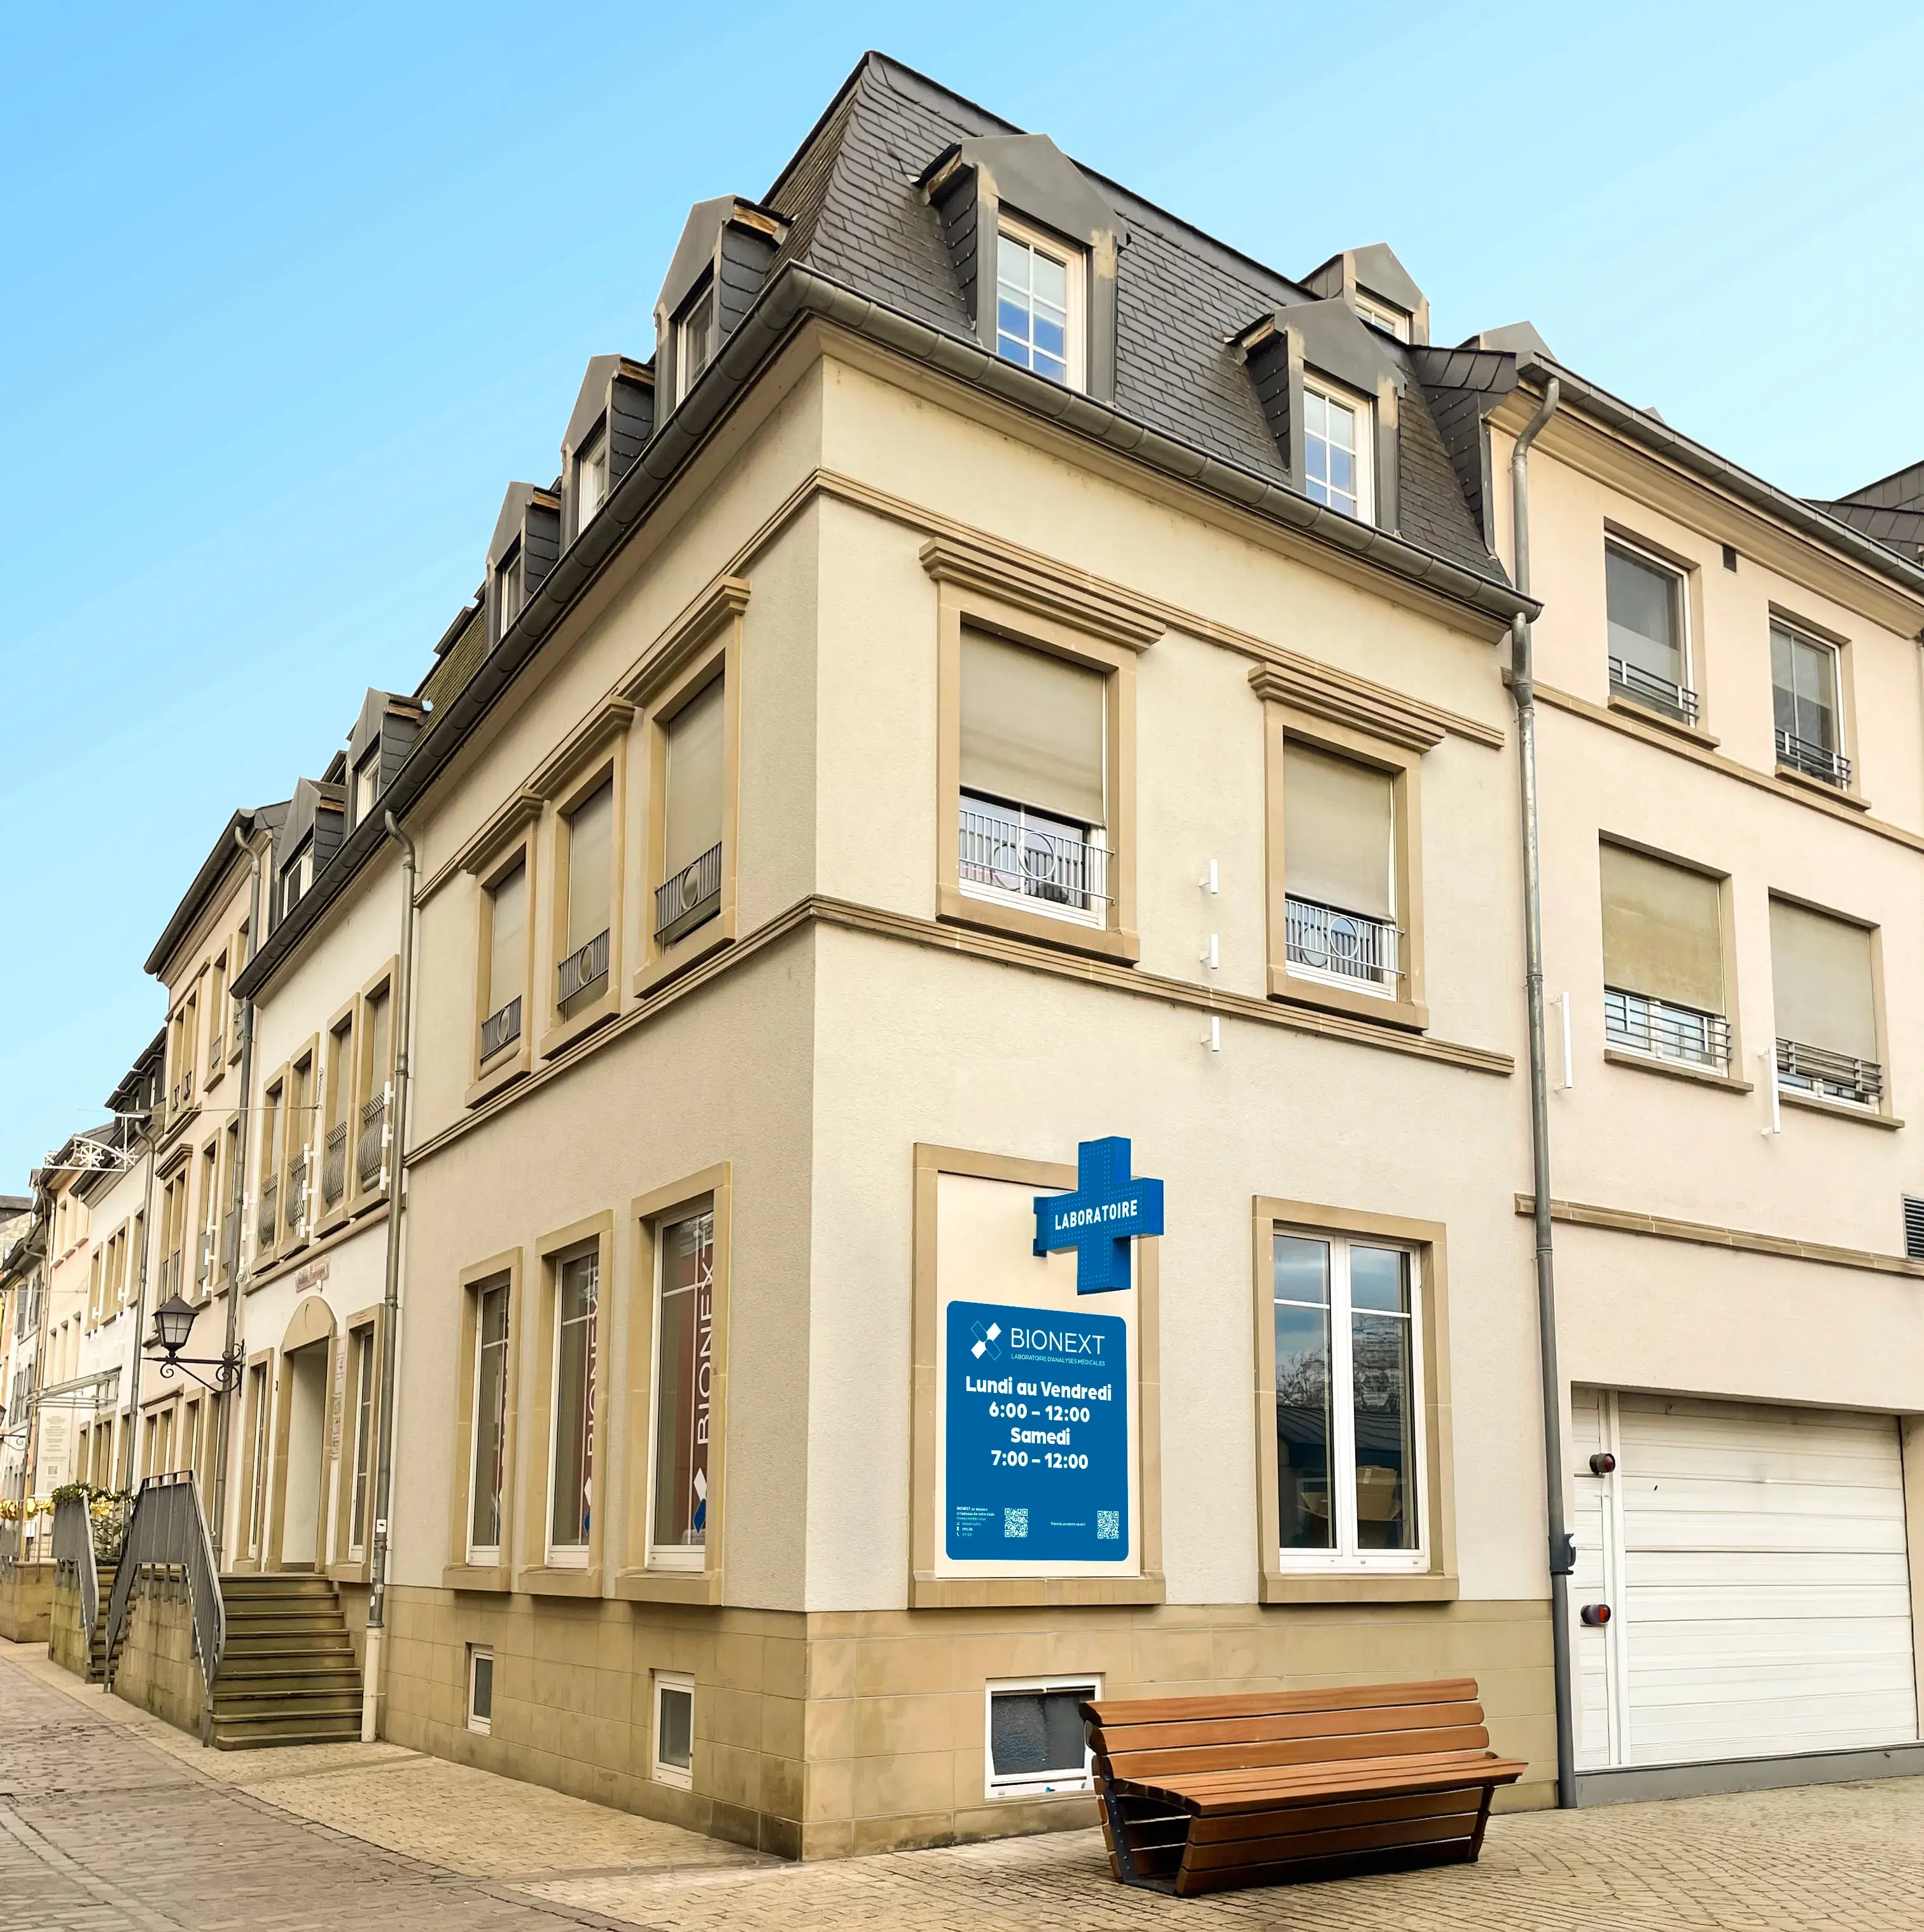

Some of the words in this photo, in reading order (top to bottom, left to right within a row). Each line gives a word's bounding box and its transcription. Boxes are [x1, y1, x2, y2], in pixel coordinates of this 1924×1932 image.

[1056, 1200, 1138, 1230] LABORATOIRE
[1012, 1328, 1105, 1355] BIONEXT
[966, 1376, 1013, 1395] Lundi
[1017, 1383, 1037, 1396] au
[1041, 1382, 1112, 1401] Vendredi
[989, 1401, 1028, 1419] 6:00
[1045, 1406, 1090, 1422] 12:00
[1010, 1427, 1070, 1445] Samedi
[991, 1450, 1028, 1466] 7:00
[1044, 1453, 1089, 1469] 12:00
